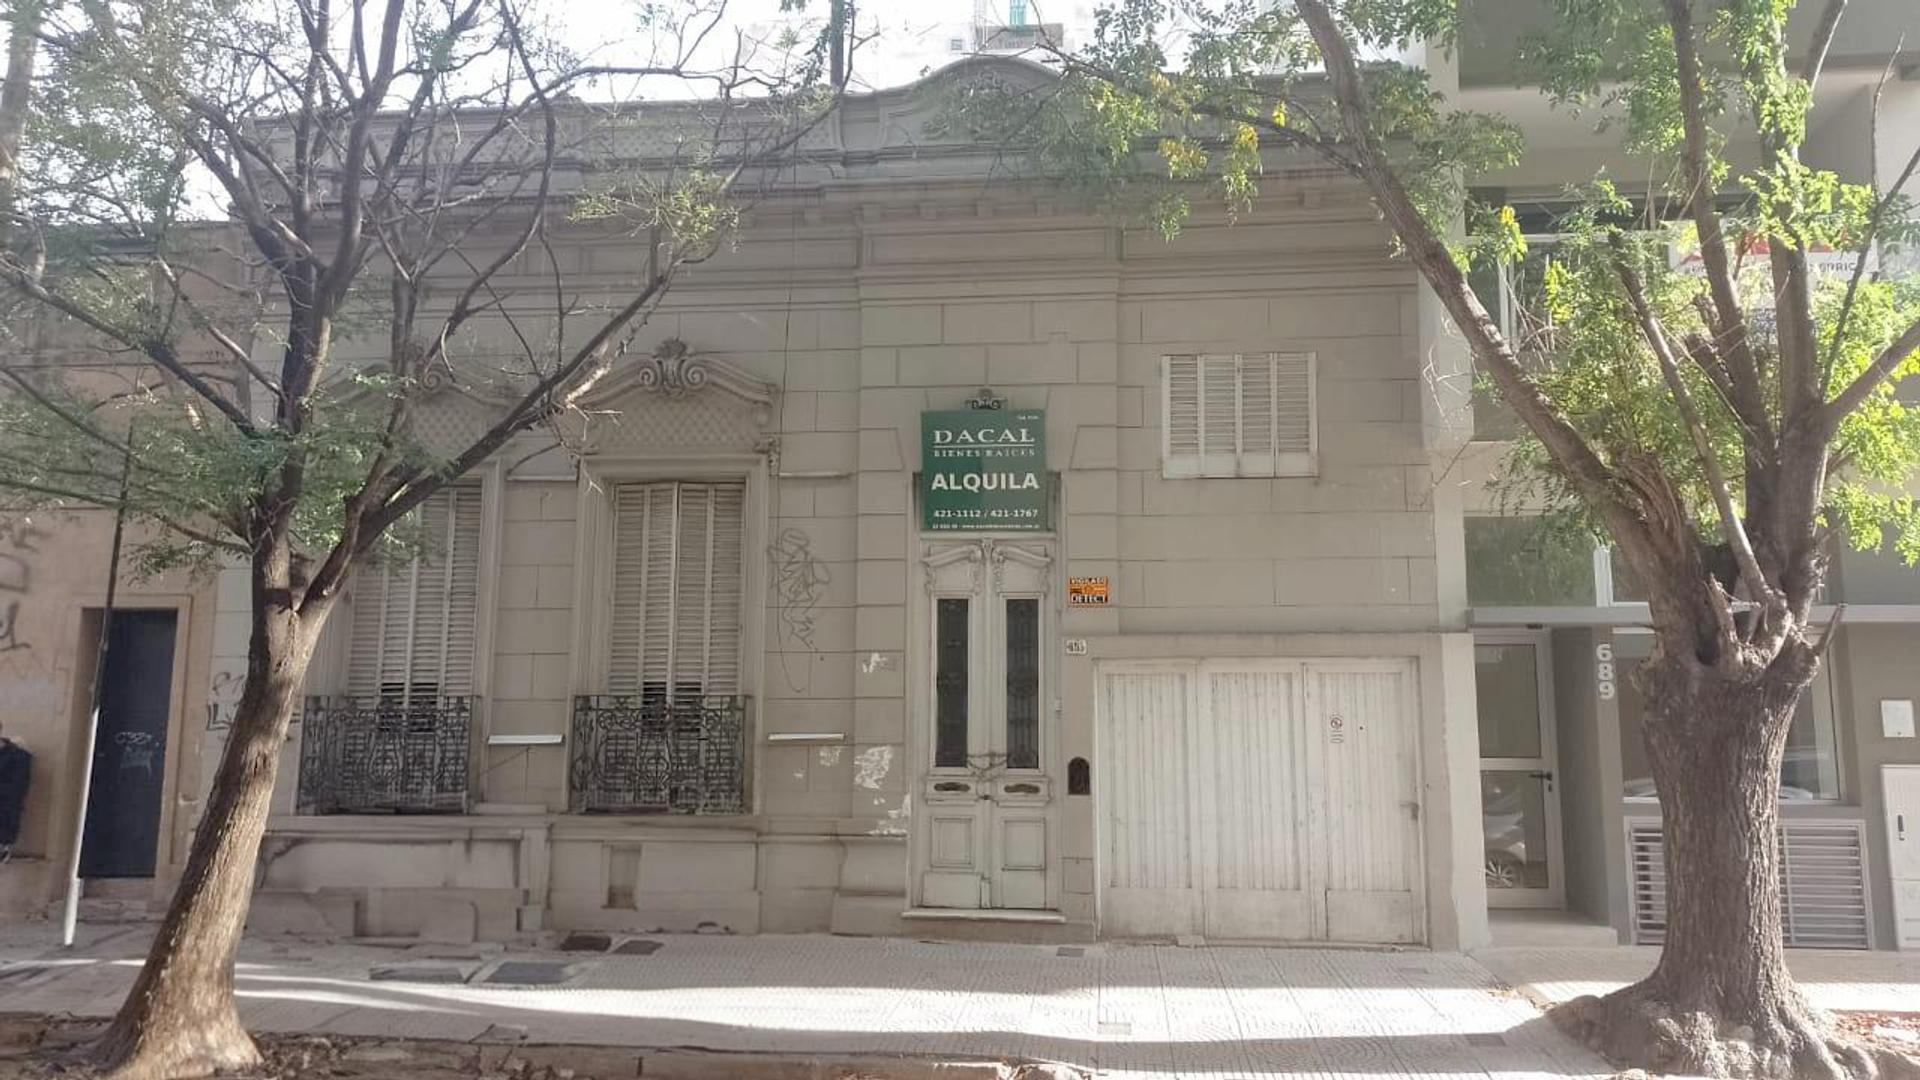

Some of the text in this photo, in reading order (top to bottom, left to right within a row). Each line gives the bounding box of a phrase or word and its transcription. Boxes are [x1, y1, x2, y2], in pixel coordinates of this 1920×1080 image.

[933, 428, 1035, 444] DACAL
[934, 450, 981, 458] BIENES
[931, 472, 1040, 493] ALQUILA
[933, 509, 981, 519] 421-1112
[990, 508, 1038, 518] 421-1767
[1071, 594, 1105, 604] DETECT
[1596, 643, 1615, 700] 689
